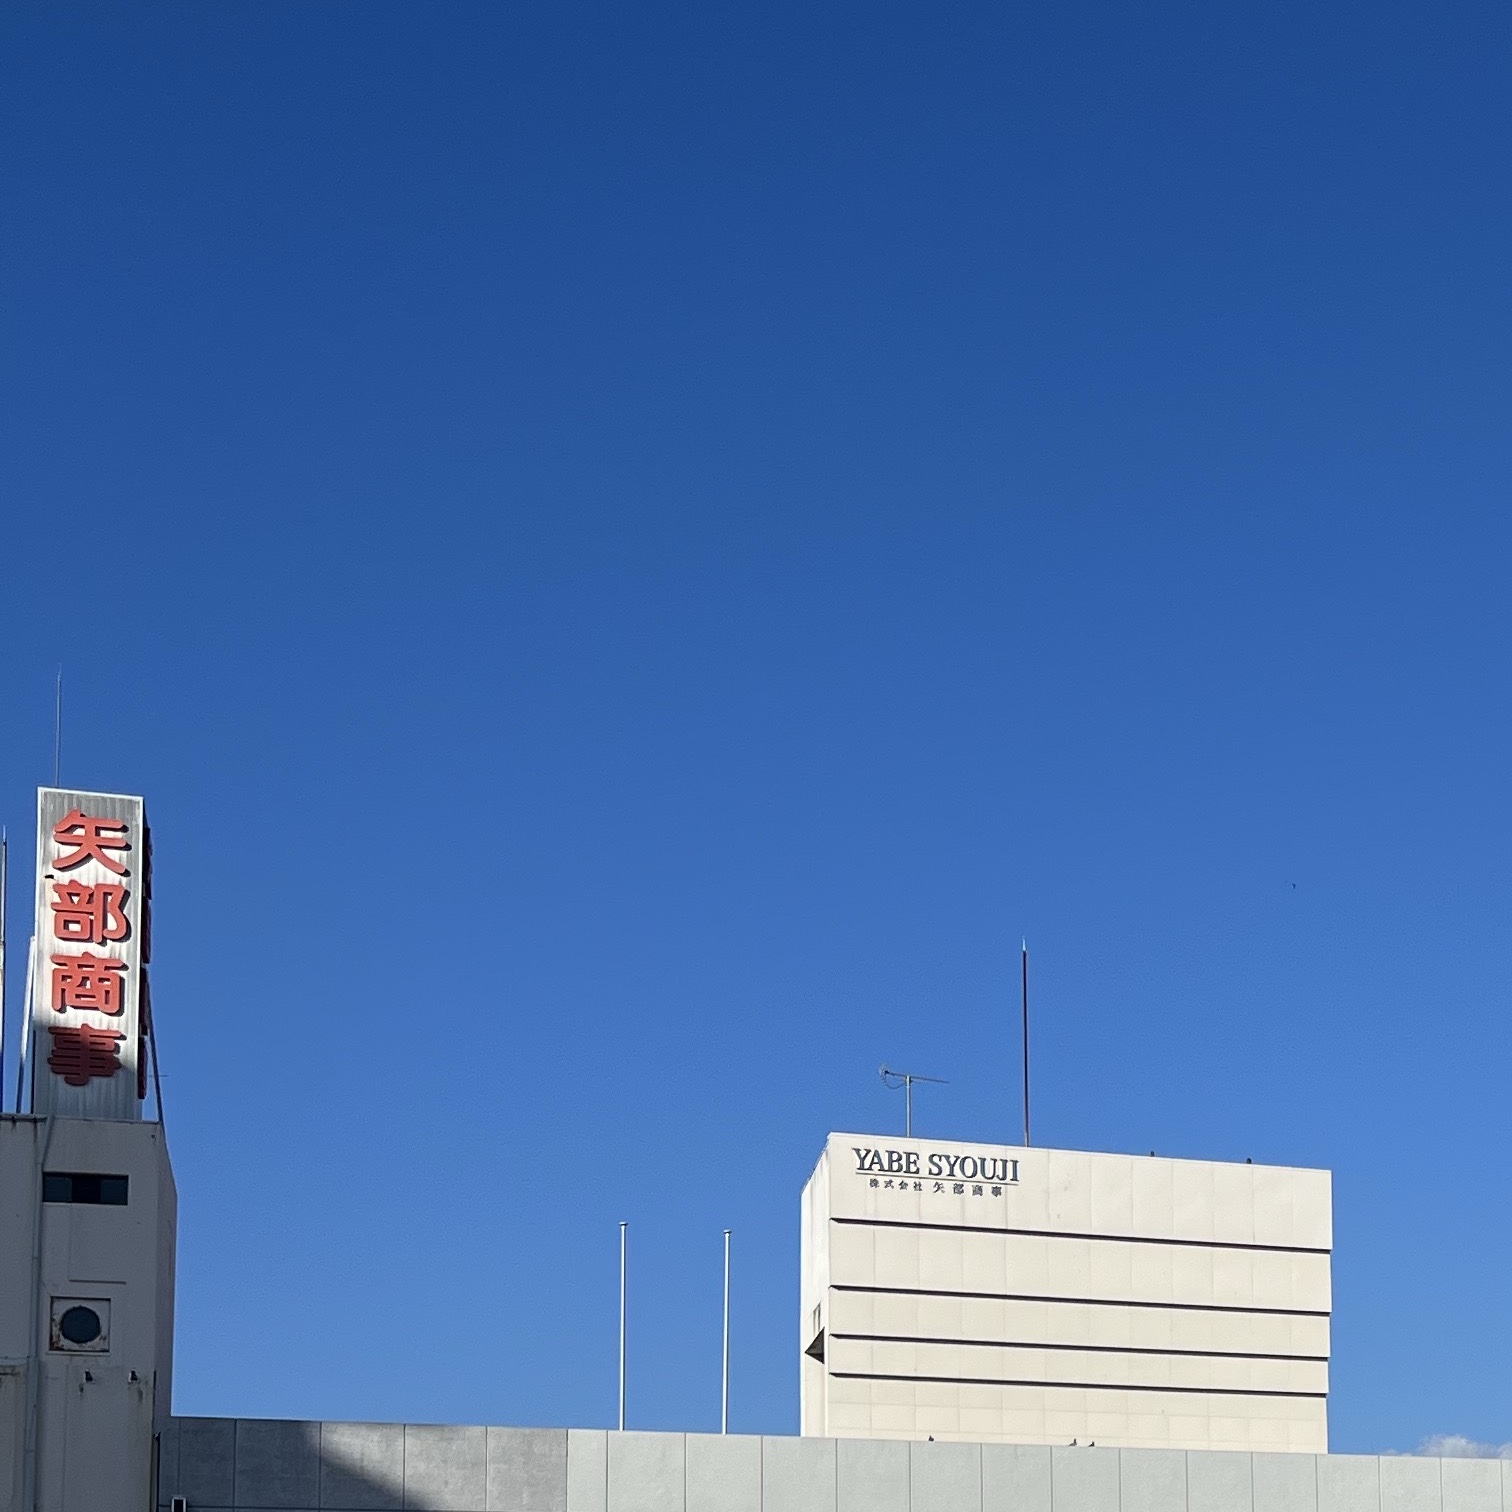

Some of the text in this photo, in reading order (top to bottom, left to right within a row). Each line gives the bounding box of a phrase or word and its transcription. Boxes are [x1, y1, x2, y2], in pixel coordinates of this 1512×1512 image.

[48, 809, 130, 1087] 矢部商事
[852, 1147, 1020, 1182] YABE SYOUJI
